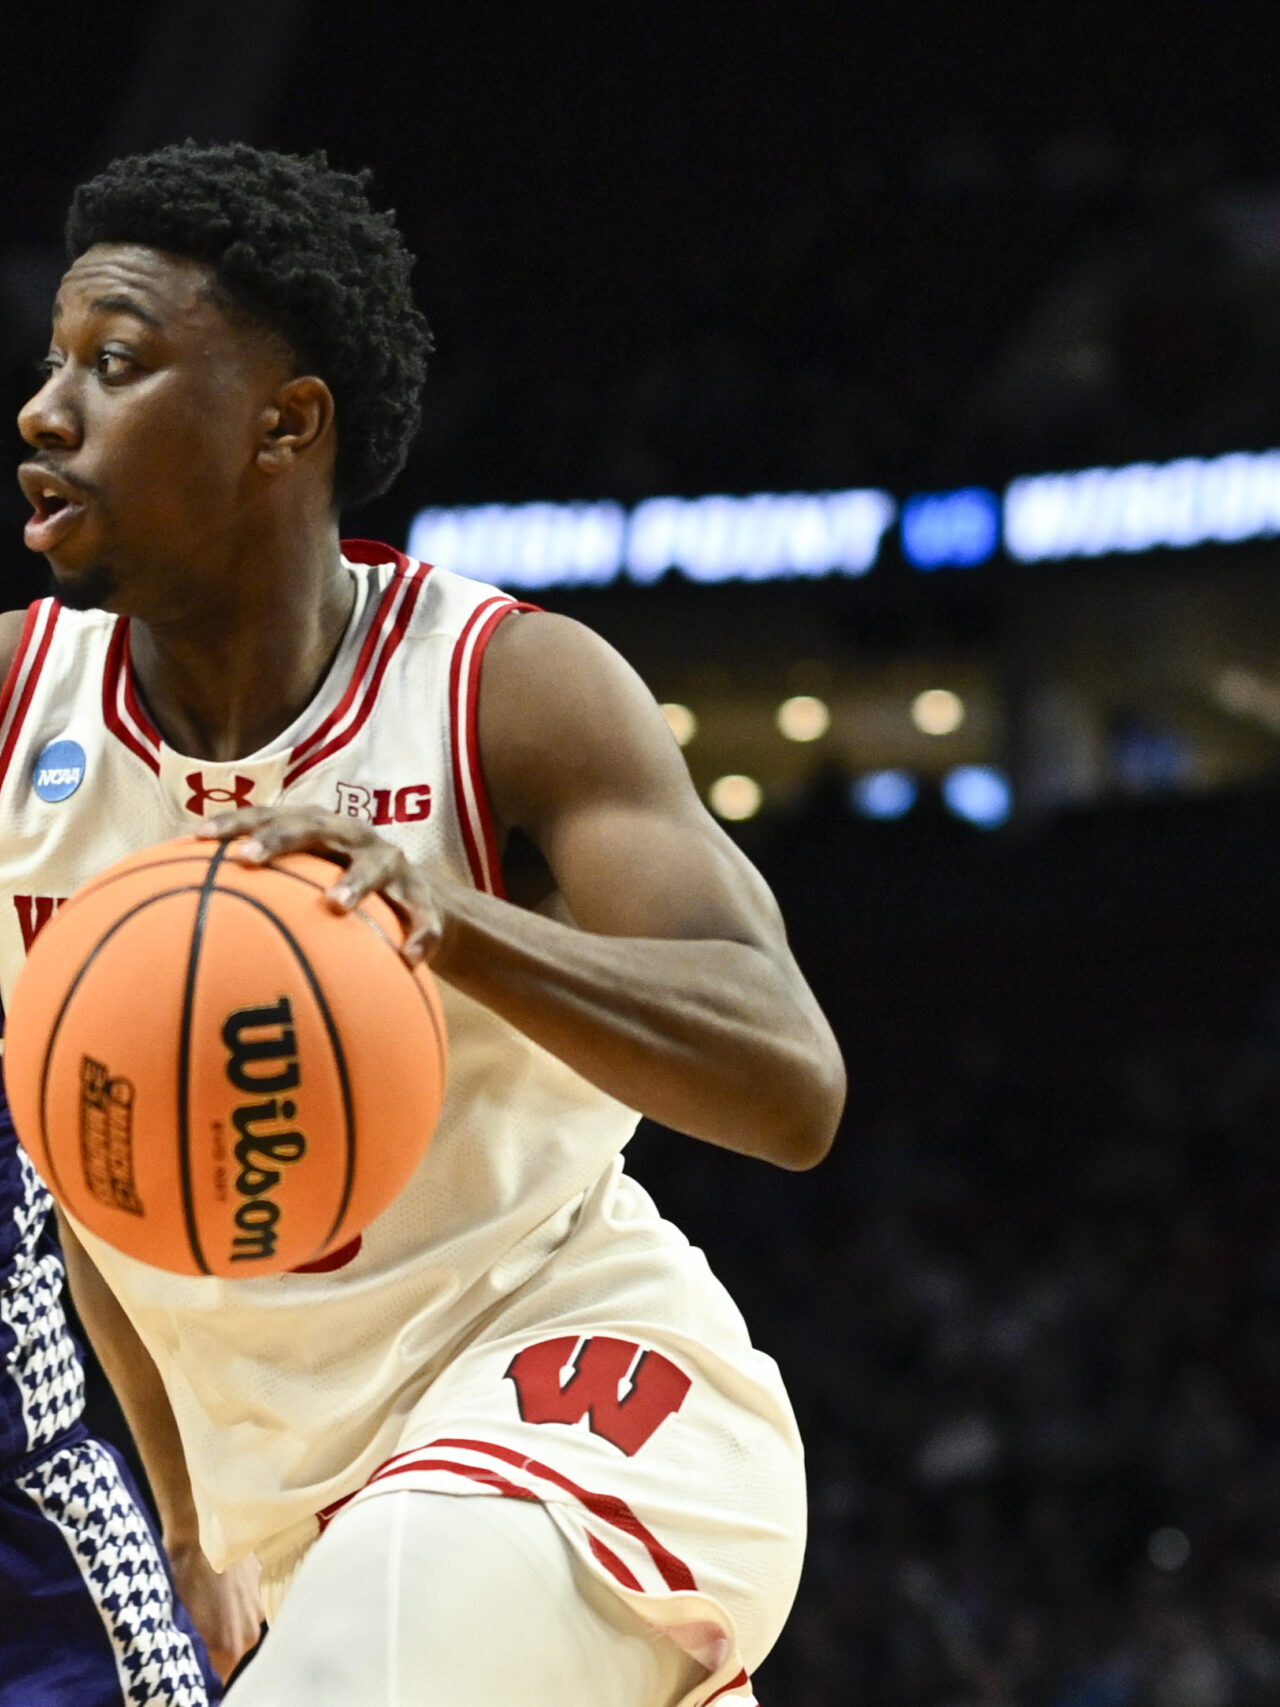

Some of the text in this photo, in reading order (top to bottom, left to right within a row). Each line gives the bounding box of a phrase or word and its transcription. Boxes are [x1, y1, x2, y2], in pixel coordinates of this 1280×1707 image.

[36, 767, 81, 787] NCAA
[222, 996, 308, 1263] Wilson
[502, 1335, 693, 1458] W
